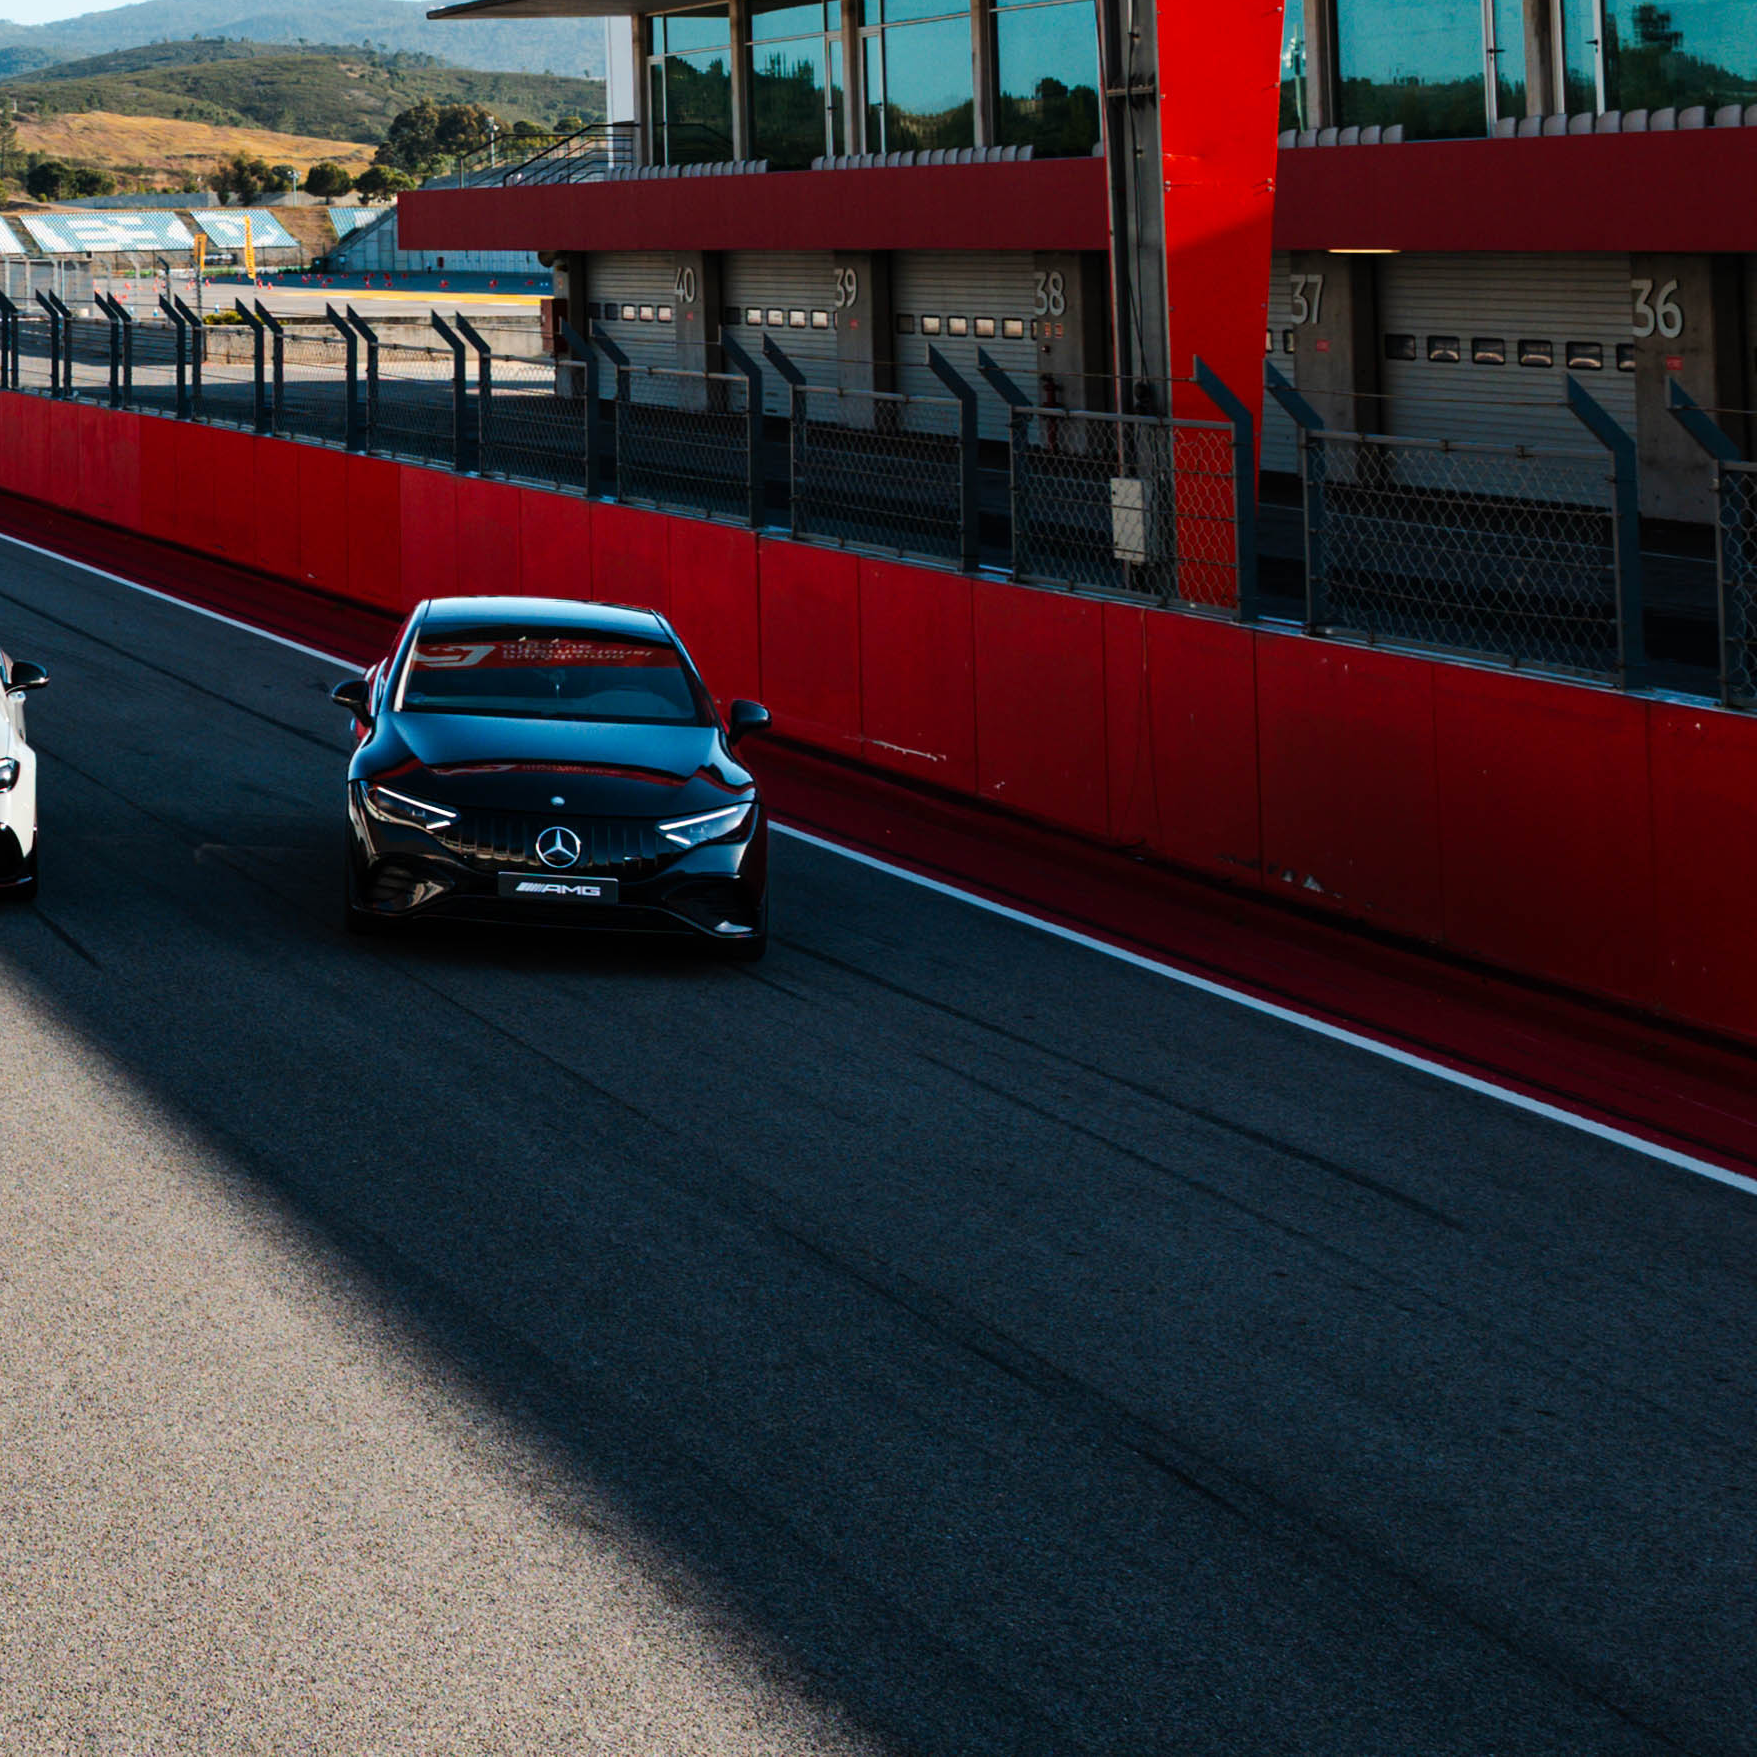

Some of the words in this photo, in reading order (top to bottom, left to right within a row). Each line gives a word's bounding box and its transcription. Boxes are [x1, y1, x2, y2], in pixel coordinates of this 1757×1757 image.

[674, 266, 696, 304] 40
[833, 267, 858, 308] 39
[1033, 271, 1066, 316] 38
[1289, 273, 1324, 324] 37
[1630, 278, 1683, 339] 36
[541, 883, 601, 897] AMG
